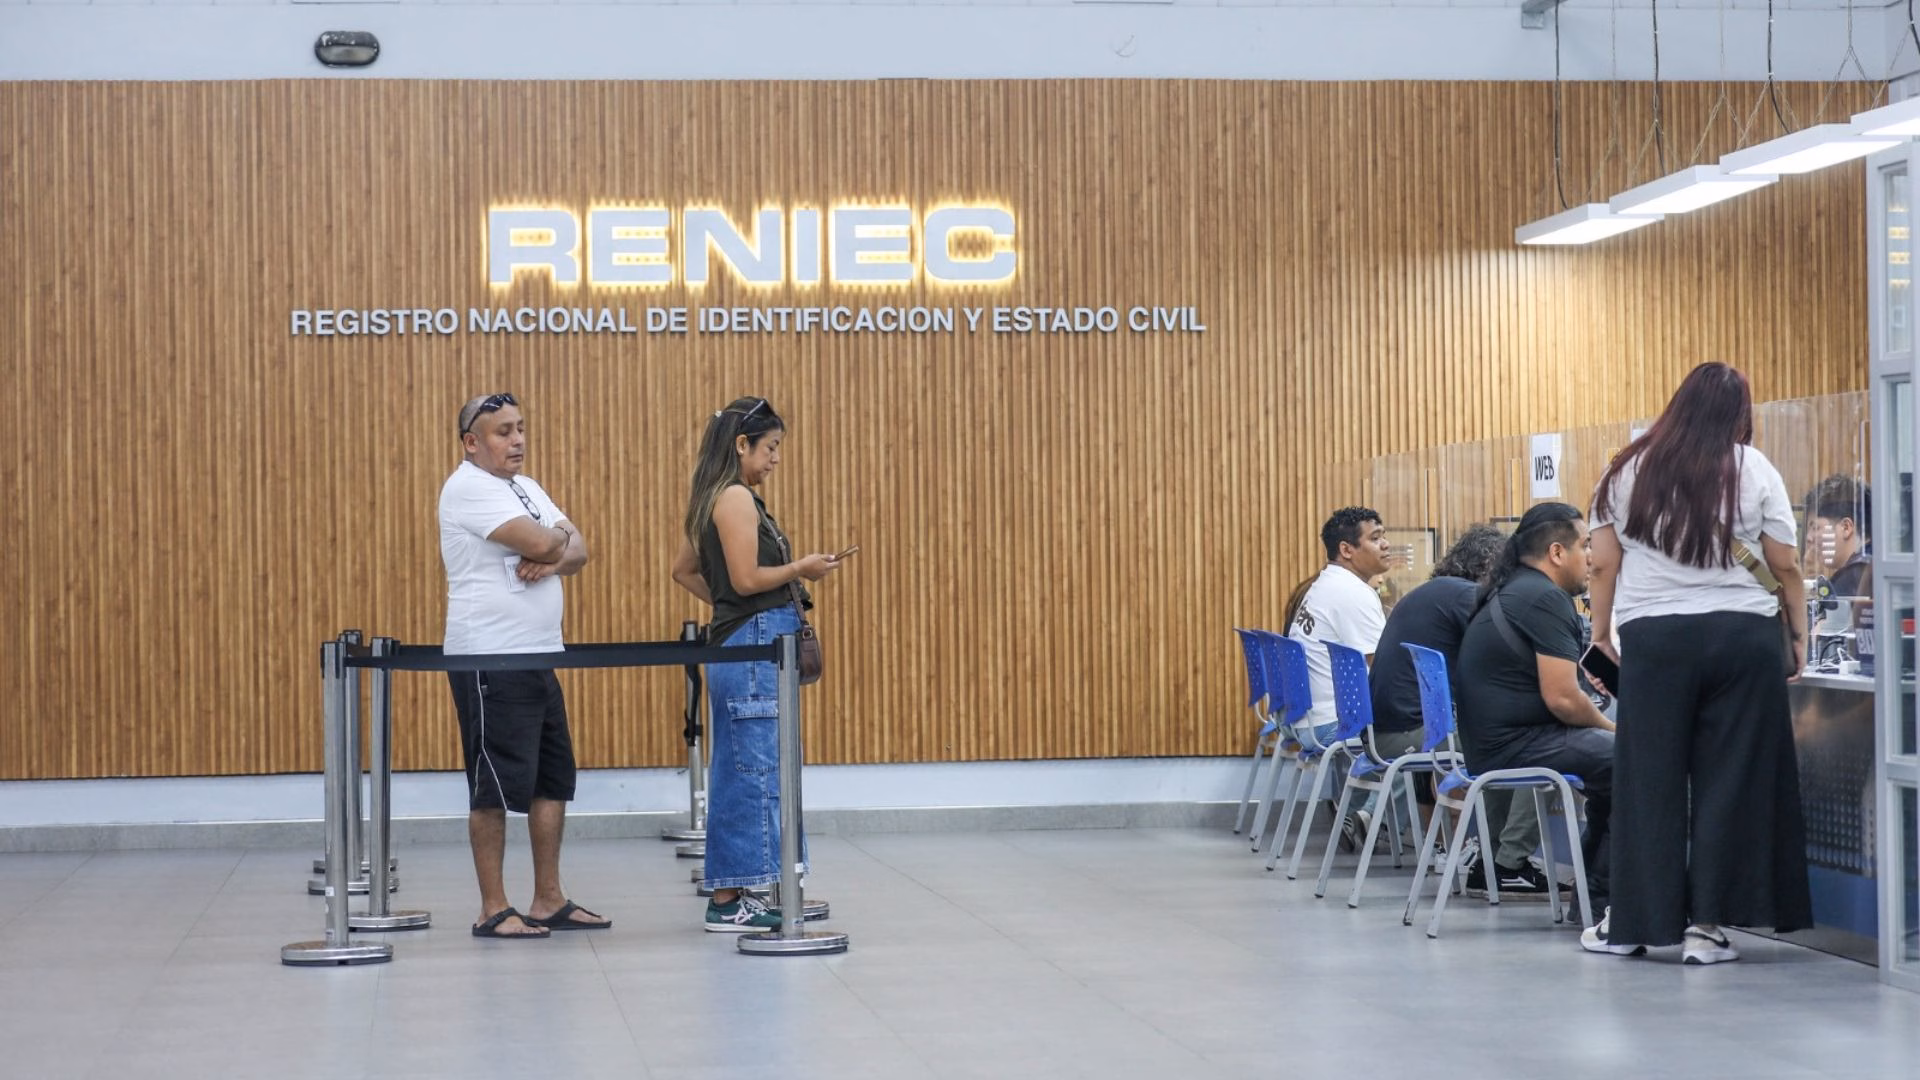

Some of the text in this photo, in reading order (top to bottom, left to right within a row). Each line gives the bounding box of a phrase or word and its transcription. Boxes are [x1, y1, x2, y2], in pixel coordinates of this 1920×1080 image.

[489, 208, 1016, 283] RENIEC
[291, 306, 1207, 334] REGISTRO NACIONAL DE IDENTIFICACION Y ESTADO CIVIL
[1534, 455, 1555, 481] WEB
